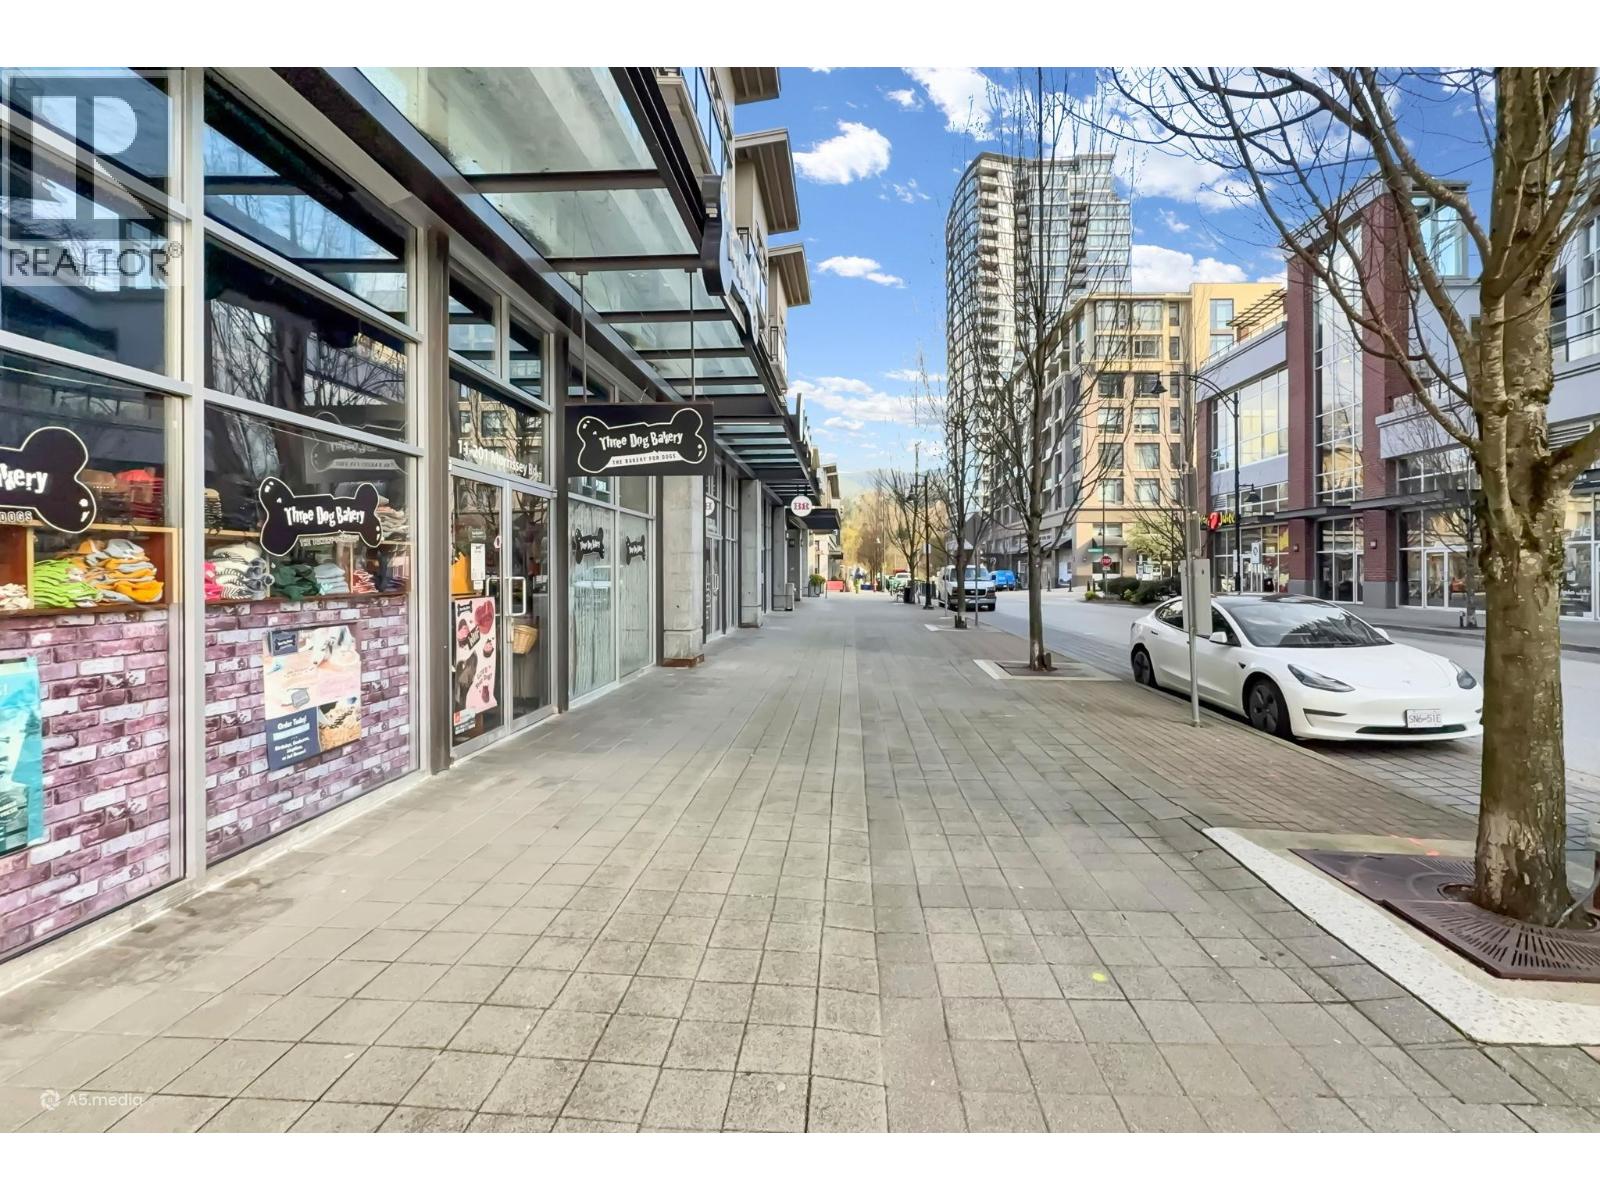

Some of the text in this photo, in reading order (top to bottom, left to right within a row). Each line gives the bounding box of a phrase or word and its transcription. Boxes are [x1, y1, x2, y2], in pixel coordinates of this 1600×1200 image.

[599, 431, 684, 451] Three Dog Bakery
[0, 463, 48, 494] kery
[284, 506, 365, 527] Three Dog Bakery
